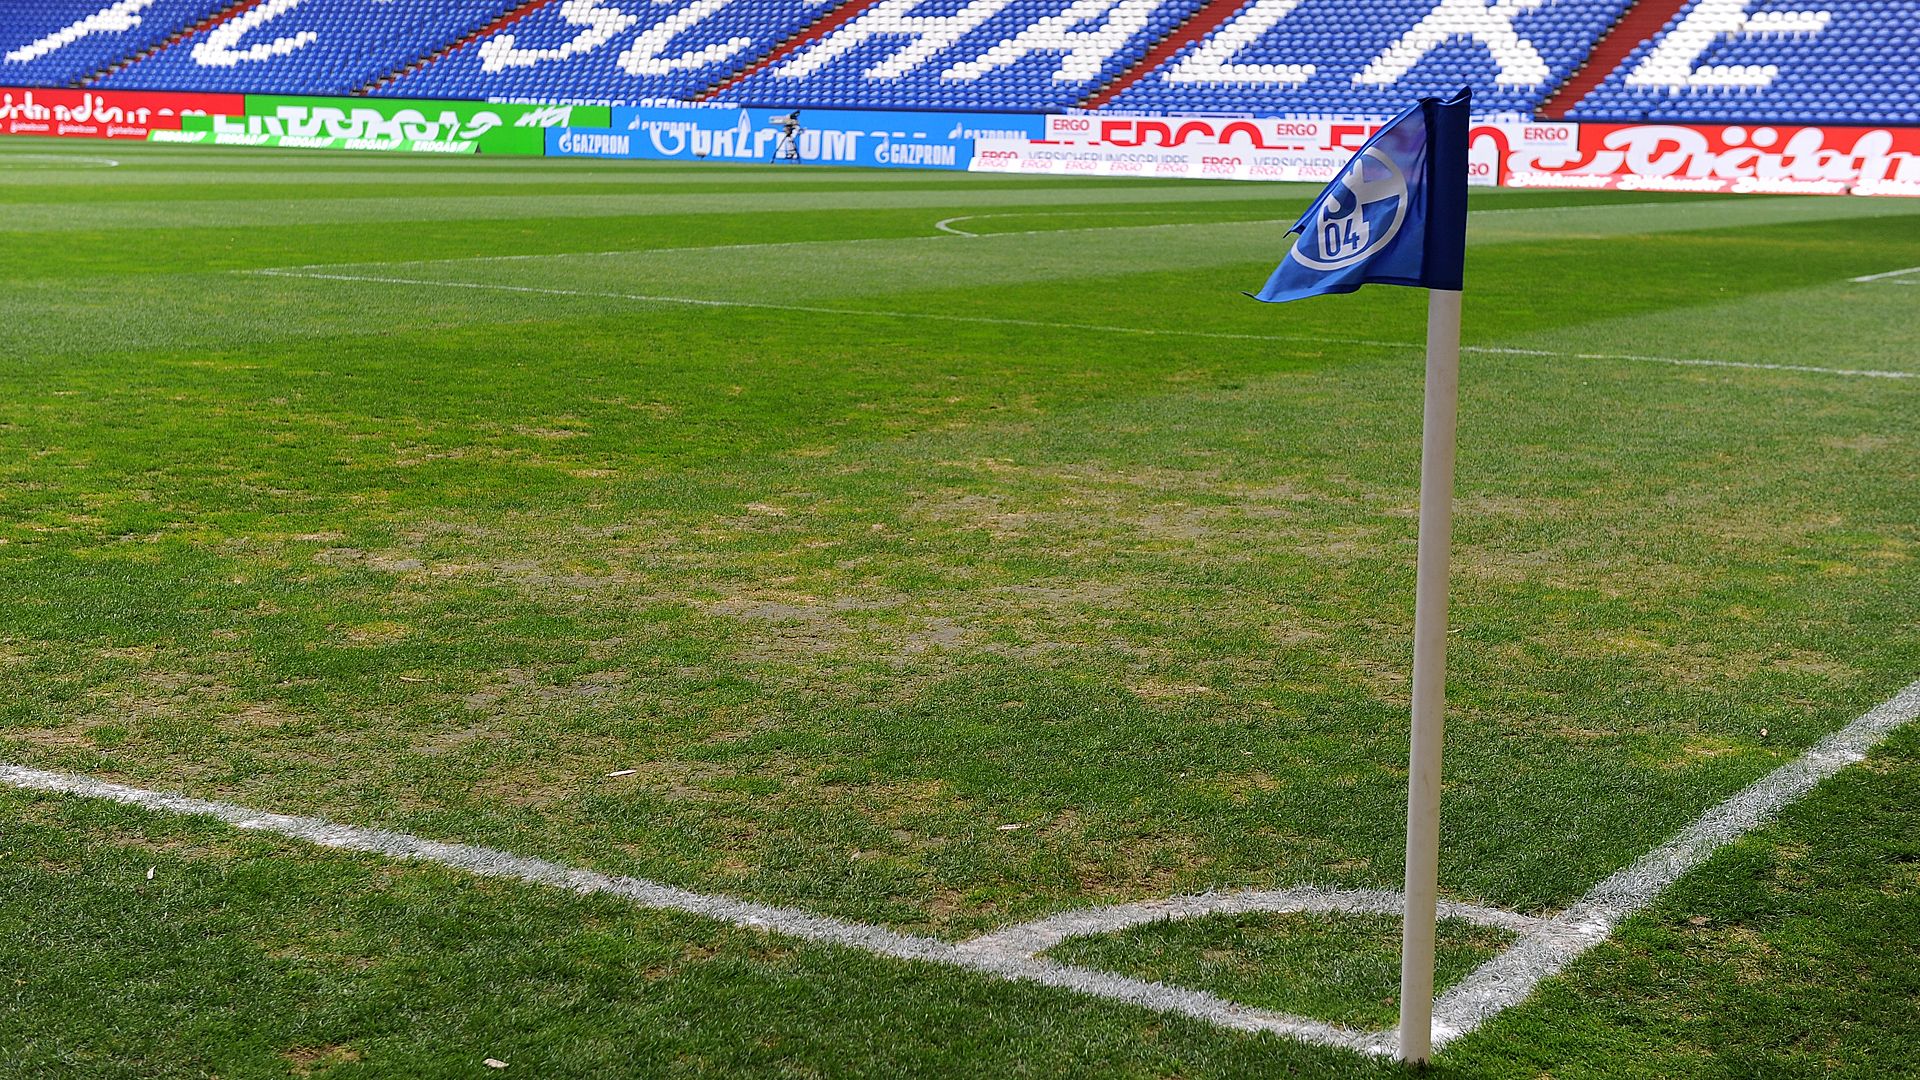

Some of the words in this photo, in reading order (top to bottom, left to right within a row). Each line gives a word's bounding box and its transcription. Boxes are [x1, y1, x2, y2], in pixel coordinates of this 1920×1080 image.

[1053, 119, 1090, 131] ERGO
[1277, 124, 1317, 136] ERGO
[1524, 127, 1569, 140] ERGO
[572, 133, 630, 155] GAZPROM
[890, 143, 956, 166] GAZPROM
[977, 157, 1009, 168] ERGO
[1021, 159, 1053, 170] ERGO
[1065, 161, 1097, 171] ERGO
[1110, 162, 1143, 172] ERGO
[1155, 163, 1189, 173] ERGO
[1202, 164, 1236, 175] ERGO
[1249, 165, 1284, 176] ERGO
[1298, 166, 1333, 177] ERGO
[1468, 162, 1489, 176] GO
[1324, 218, 1360, 257] 04
